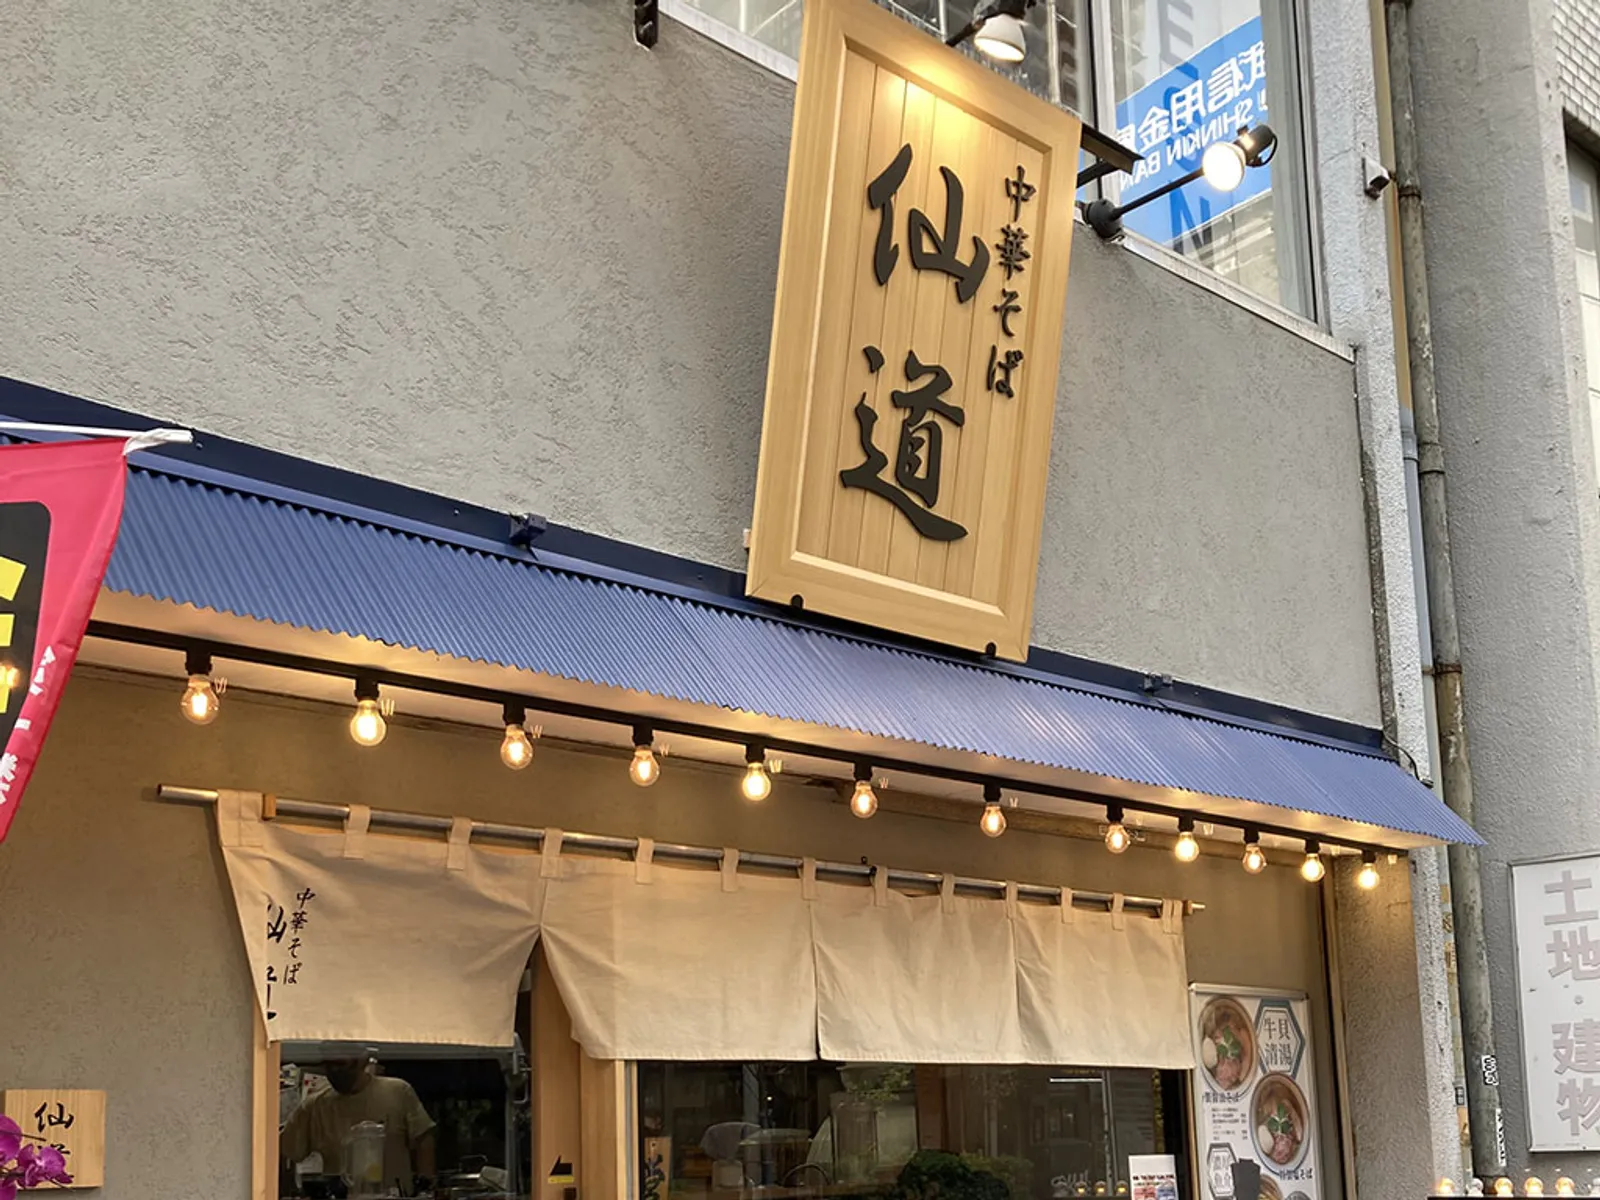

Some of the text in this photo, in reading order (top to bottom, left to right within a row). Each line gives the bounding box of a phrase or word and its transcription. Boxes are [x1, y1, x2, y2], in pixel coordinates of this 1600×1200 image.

[839, 143, 990, 542] 仙道
[985, 164, 1037, 399] 中華そば
[283, 887, 316, 985] 中華そば
